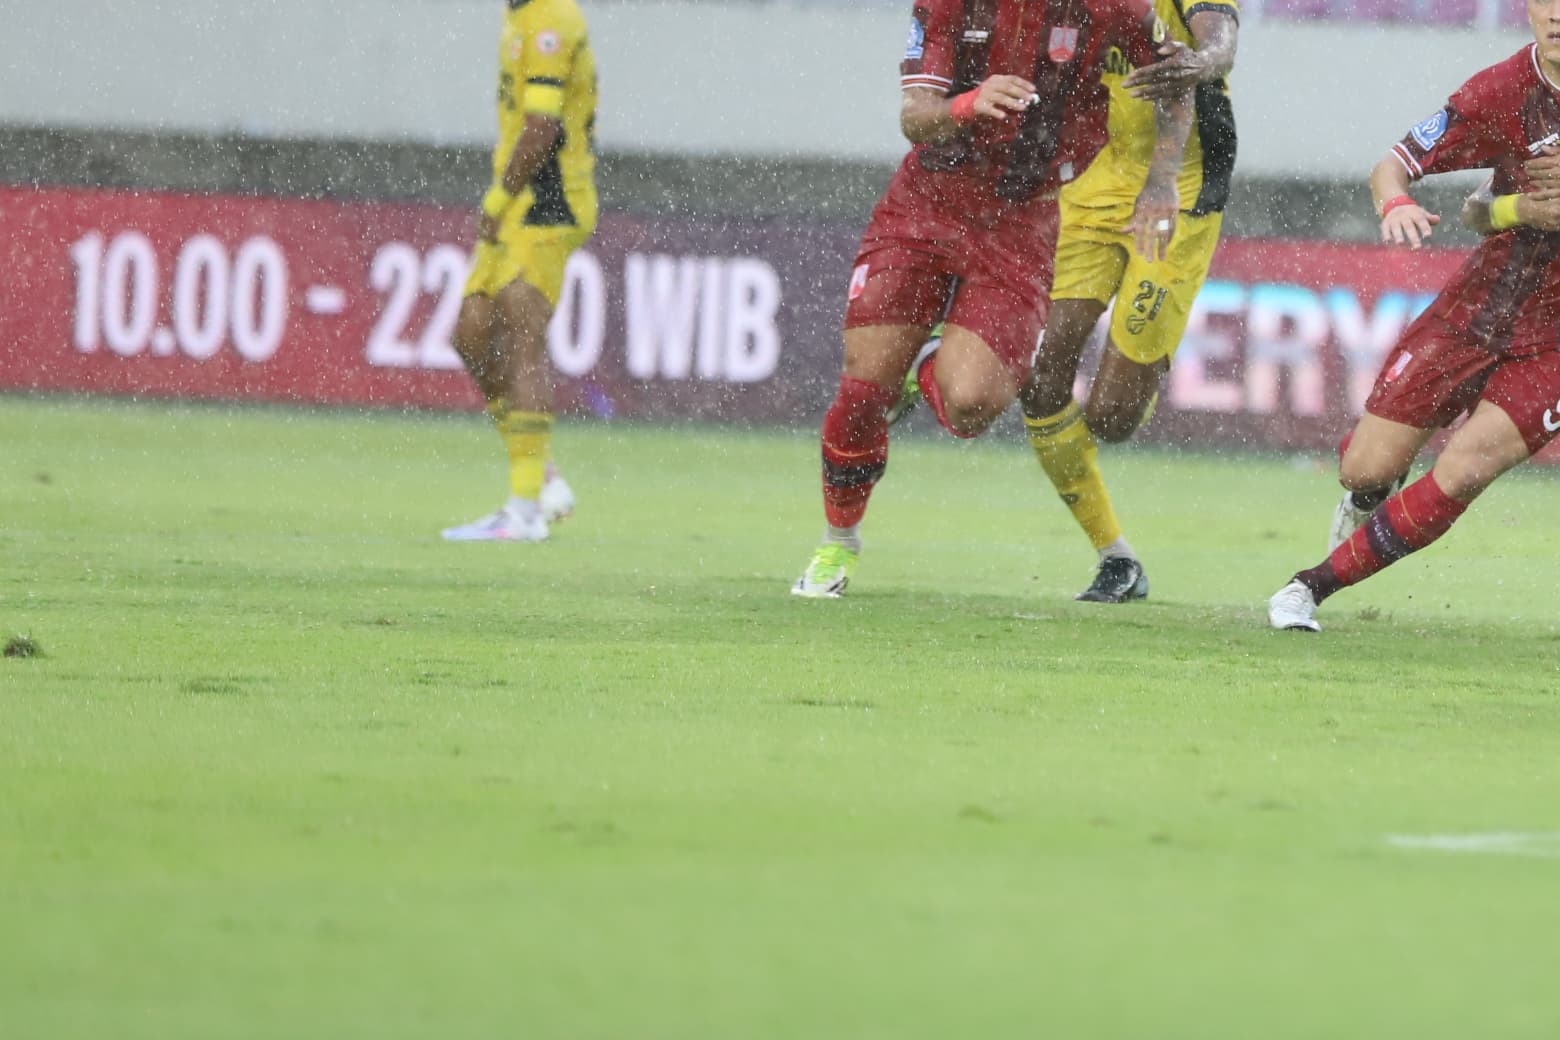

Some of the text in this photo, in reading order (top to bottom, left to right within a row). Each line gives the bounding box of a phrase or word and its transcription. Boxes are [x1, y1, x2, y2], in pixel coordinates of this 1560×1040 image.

[70, 229, 290, 360] 10.00
[366, 242, 605, 377] 220
[624, 252, 781, 382] WIB
